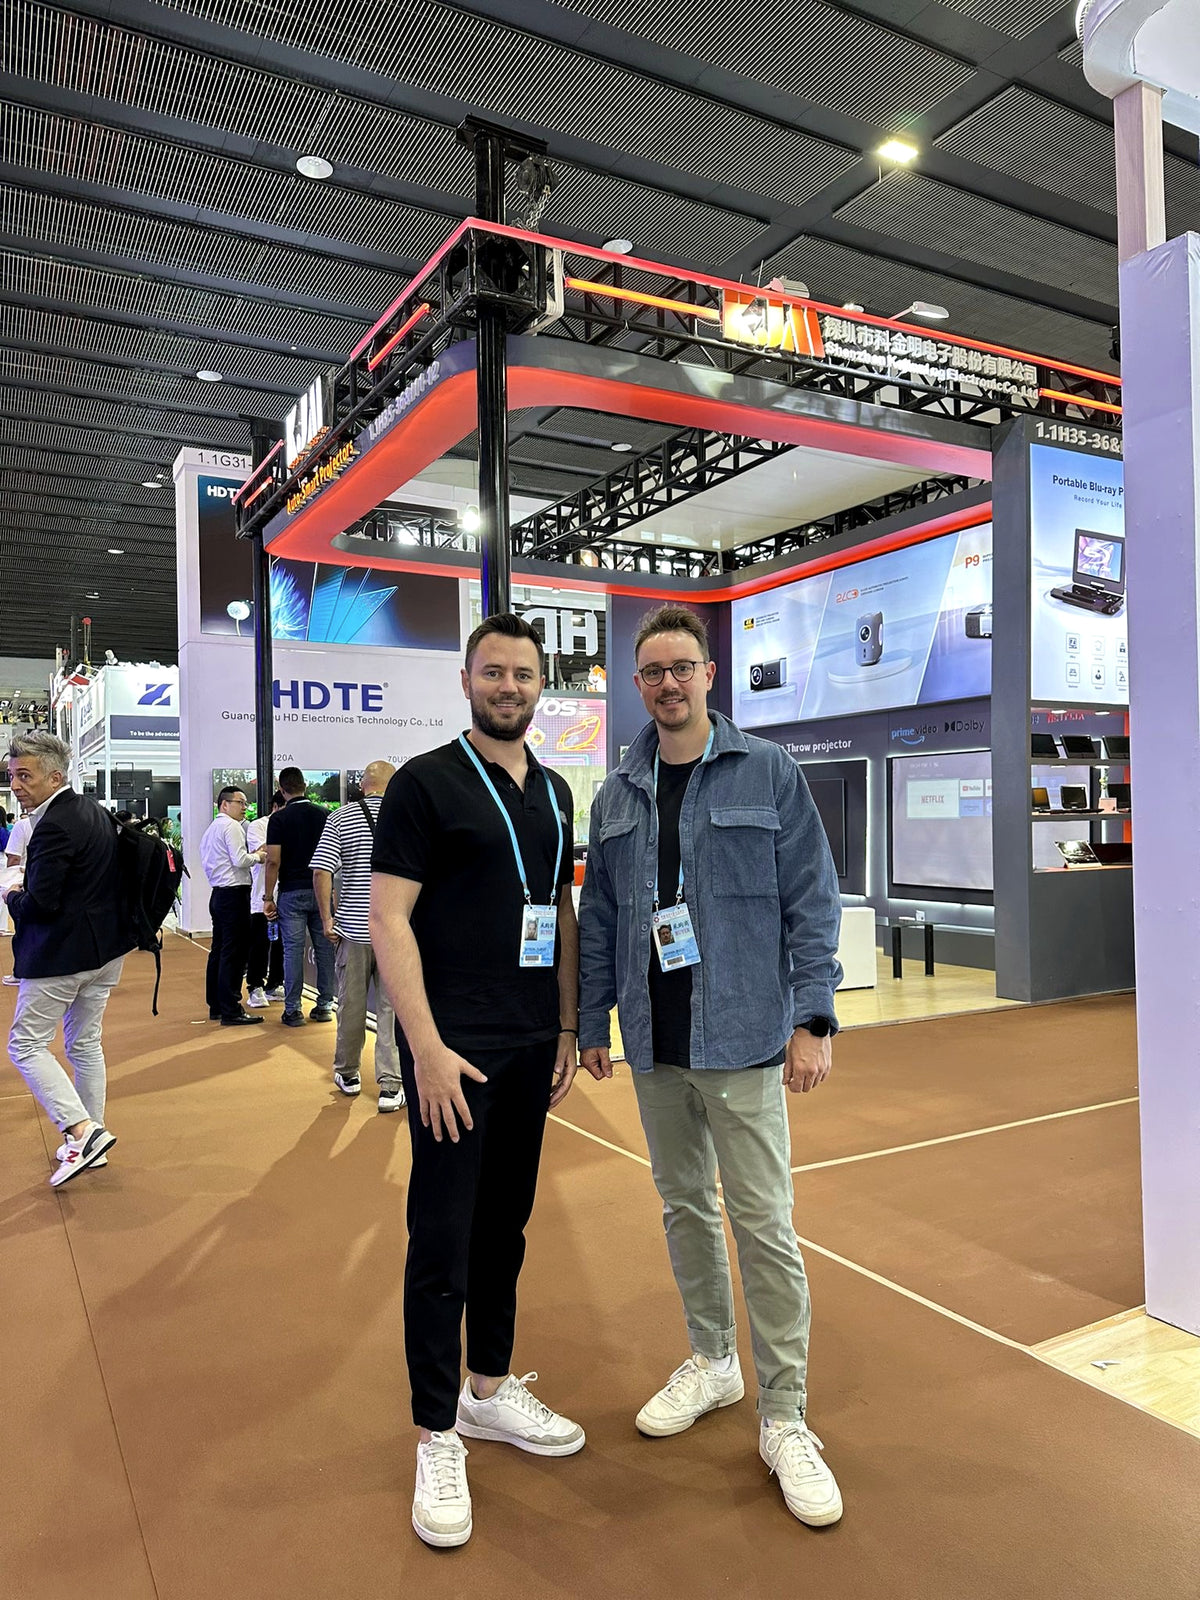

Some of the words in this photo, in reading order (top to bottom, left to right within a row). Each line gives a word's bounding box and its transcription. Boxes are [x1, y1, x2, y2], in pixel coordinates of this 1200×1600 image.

[825, 341, 886, 367] Shenzhen
[319, 440, 354, 483] Projectors
[207, 485, 241, 499] HDT
[1052, 474, 1088, 490] Portable
[1089, 481, 1118, 497] Blu-ray
[1073, 494, 1095, 504] Record
[1096, 498, 1110, 507] Your
[1111, 501, 1122, 509] Life
[283, 713, 299, 722] HD
[301, 713, 354, 724] Electronics
[357, 716, 408, 727] Technology
[956, 720, 985, 733] Dolby
[786, 743, 811, 753] Throw
[813, 740, 852, 753] projector
[921, 795, 945, 804] NETFLIX
